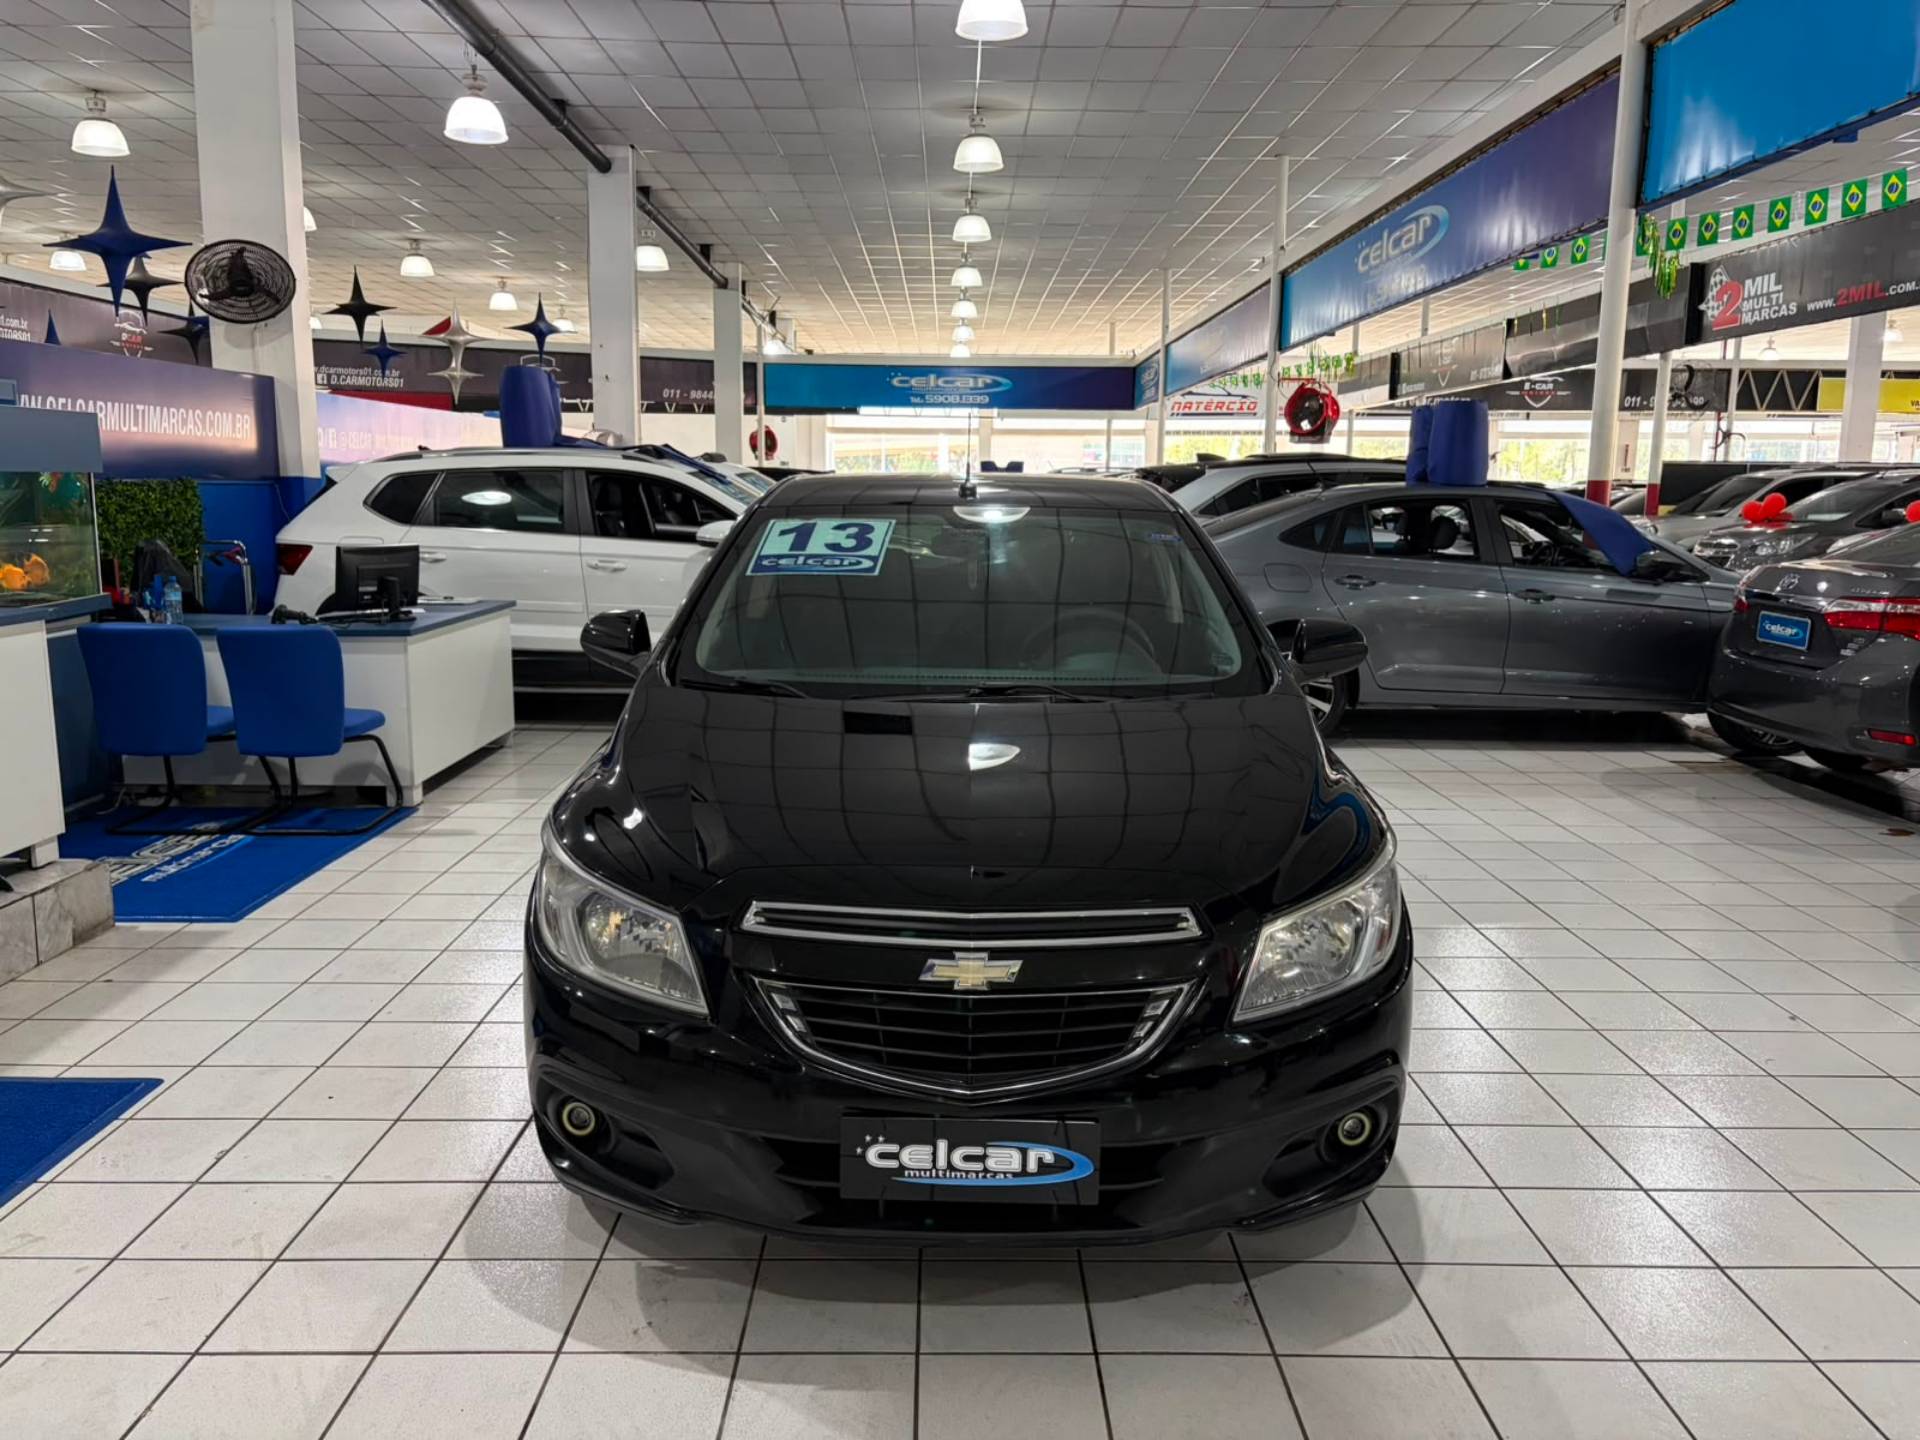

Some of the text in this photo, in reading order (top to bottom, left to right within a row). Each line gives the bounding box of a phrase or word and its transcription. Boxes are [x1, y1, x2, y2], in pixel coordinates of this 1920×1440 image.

[1358, 214, 1432, 272] celcar
[1711, 272, 1783, 331] 2 MIL
[1742, 292, 1784, 314] MULTI
[1741, 302, 1798, 325] MARCAS
[890, 374, 993, 388] celcar
[662, 388, 681, 399] 011
[1624, 396, 1642, 407] 011
[778, 522, 876, 553] 13
[761, 556, 863, 566] celcar
[1765, 622, 1797, 635] celcar
[865, 1139, 1055, 1173] celcar
[904, 1168, 1015, 1180] multimarcas
